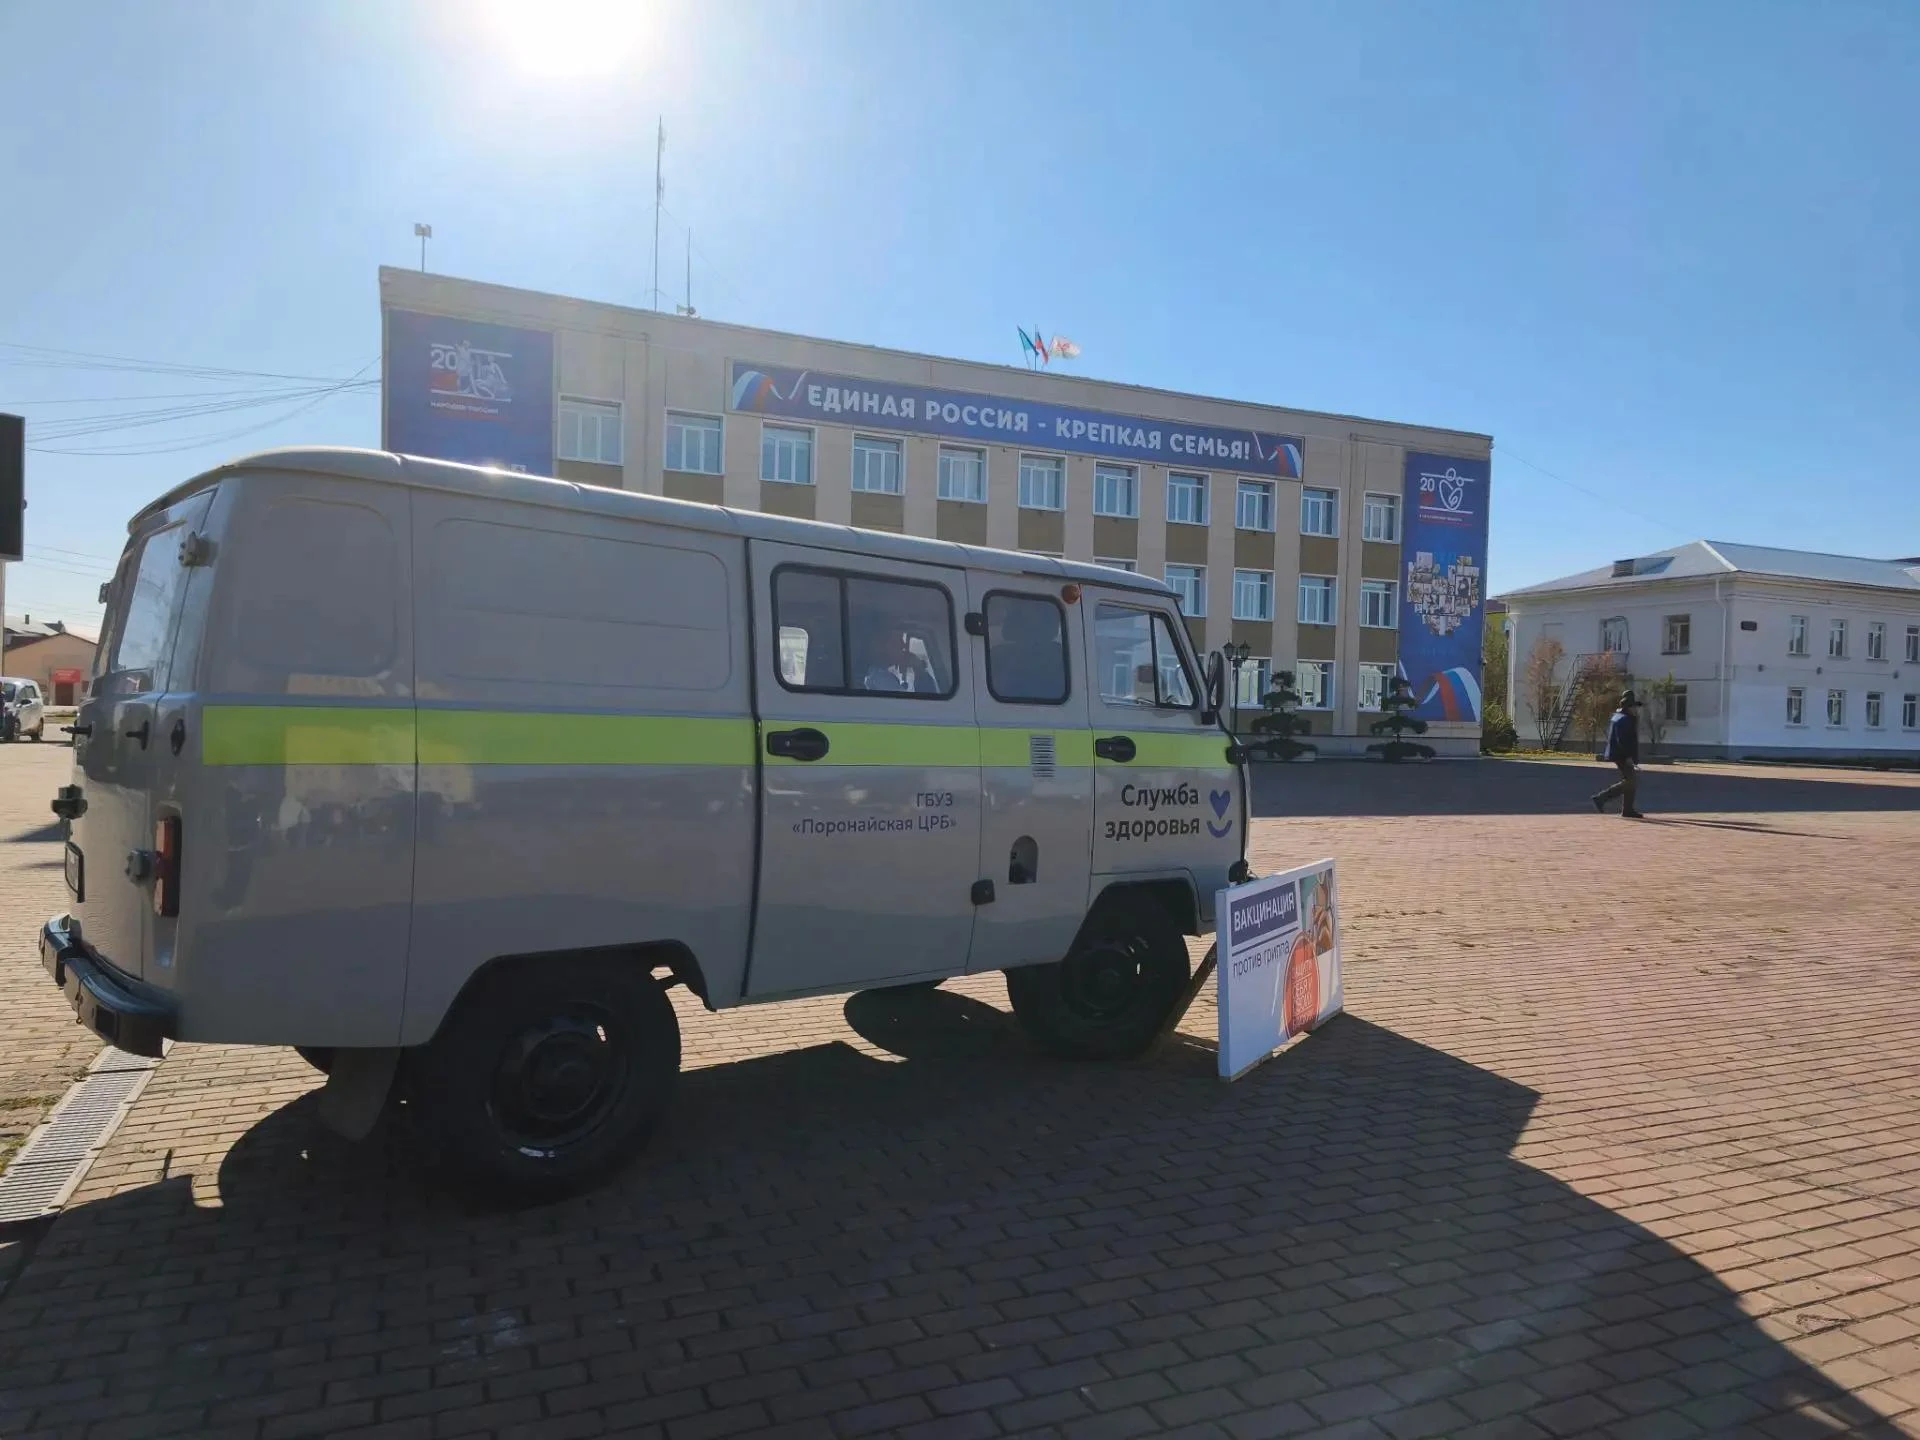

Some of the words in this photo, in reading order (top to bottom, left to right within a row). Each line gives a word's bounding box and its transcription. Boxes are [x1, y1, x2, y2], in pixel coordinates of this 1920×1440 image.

[431, 348, 457, 371] 20
[807, 384, 915, 419] ЕДИНАЯ
[925, 400, 1028, 432] РОССИЯ
[1056, 417, 1161, 450] КРЕПКАЯ
[1169, 433, 1250, 460] СЕМЬЯ!
[1420, 477, 1434, 492] 20
[916, 792, 953, 807] ГБУЗ
[1121, 782, 1199, 811] Служба
[792, 816, 913, 837] «Поронайская
[918, 814, 957, 832] ЦРБ»
[1105, 818, 1200, 842] здоровья
[1234, 891, 1295, 932] ВАКЦИНАЦИЯ
[1233, 952, 1262, 978] против
[1264, 939, 1290, 966] гриппа
